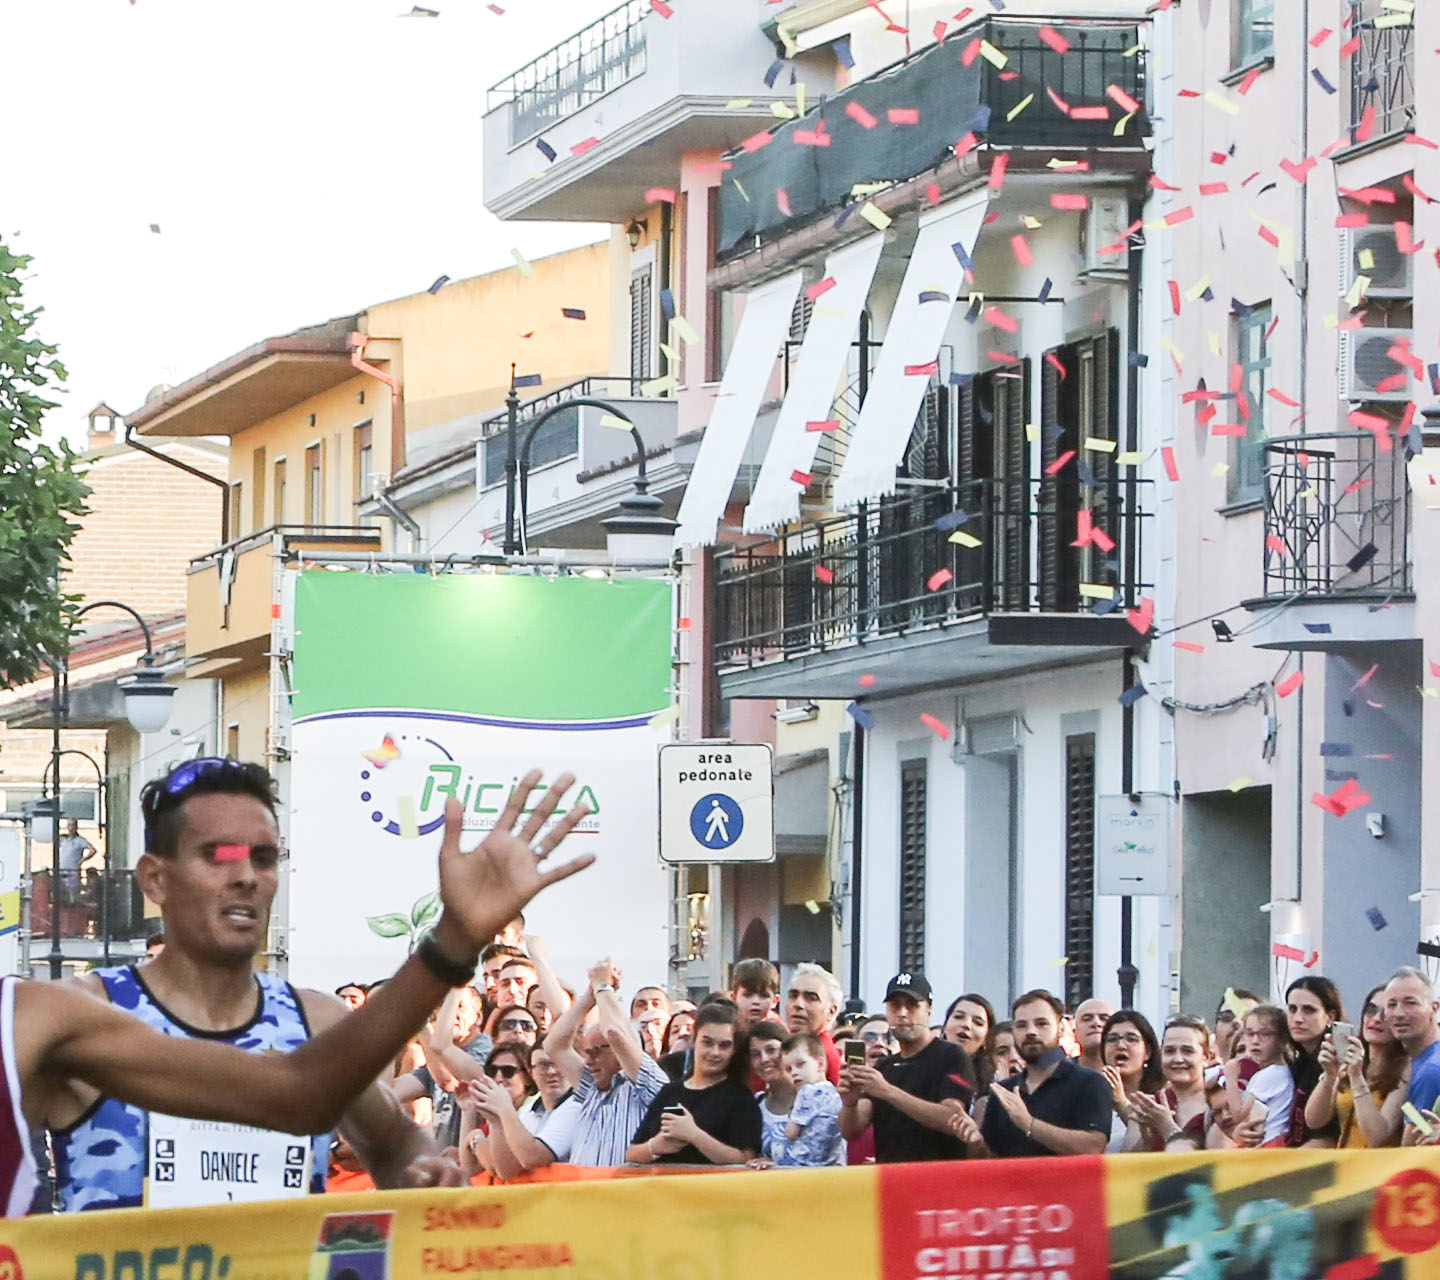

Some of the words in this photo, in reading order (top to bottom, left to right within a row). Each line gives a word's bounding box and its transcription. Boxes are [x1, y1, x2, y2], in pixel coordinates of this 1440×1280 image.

[678, 768, 753, 784] pedonale
[698, 754, 732, 765] area
[200, 1150, 261, 1184] DANIELE
[422, 1201, 508, 1233] SANNIO
[915, 1203, 1075, 1238] TROFEO
[1380, 1181, 1440, 1234] 13
[420, 1242, 576, 1275] FALANGHINA
[915, 1235, 1035, 1273] CITTÀ
